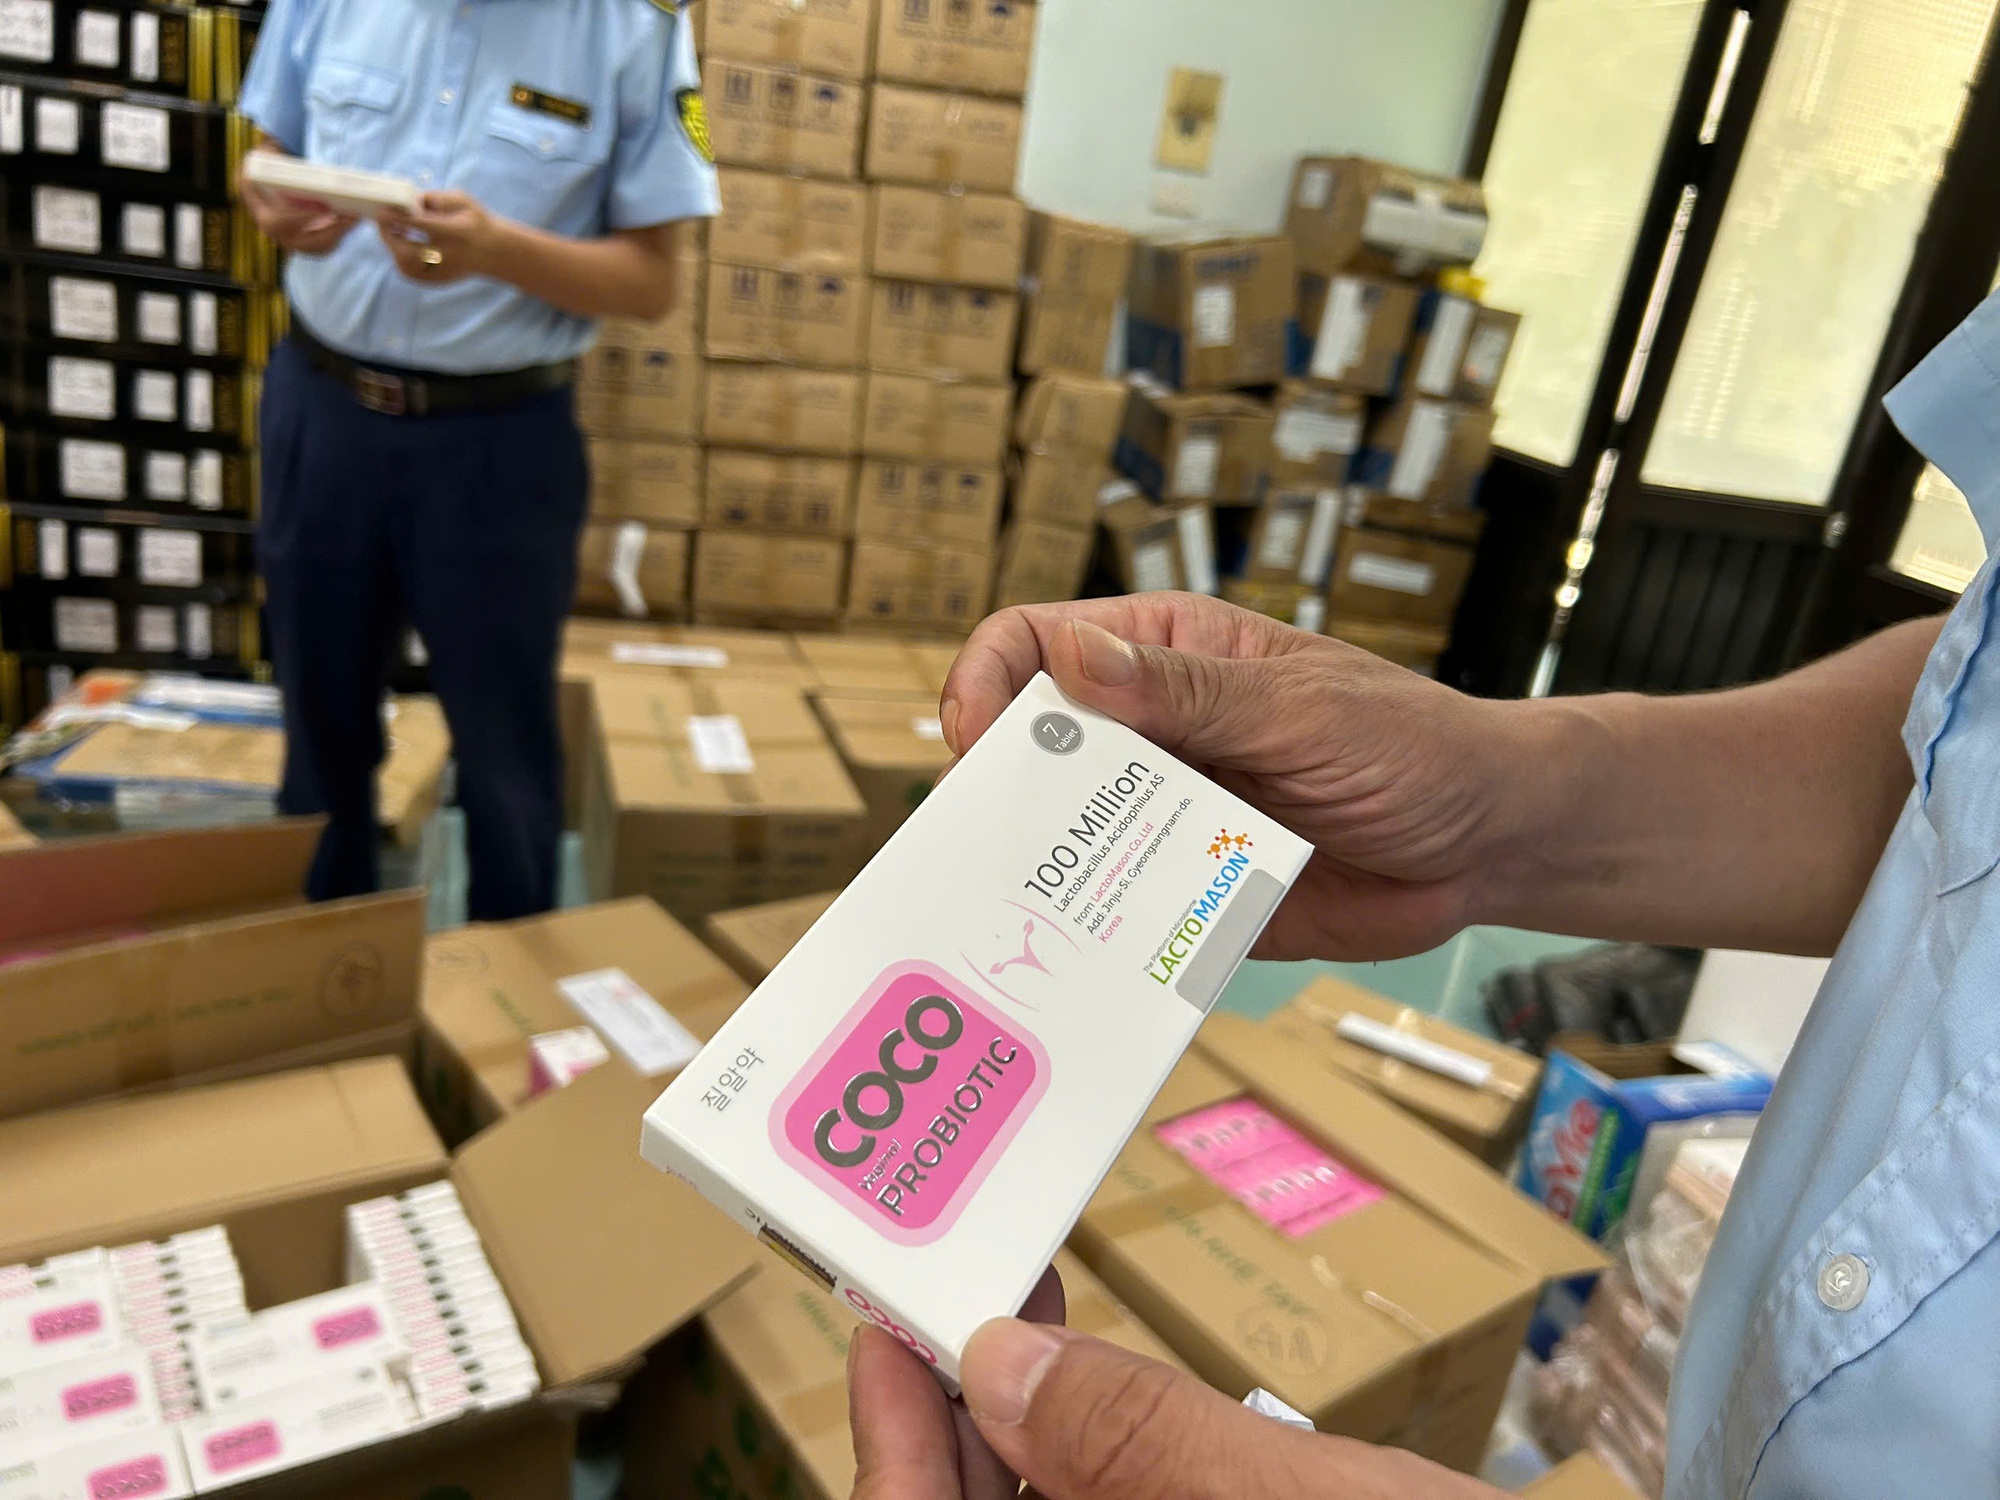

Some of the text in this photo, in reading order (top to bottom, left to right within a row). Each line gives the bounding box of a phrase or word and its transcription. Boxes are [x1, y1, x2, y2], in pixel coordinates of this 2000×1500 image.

[1042, 722, 1059, 738] 7
[1054, 729, 1079, 751] Tablet
[1024, 761, 1150, 898] 100 Million
[1054, 773, 1165, 912] Lactobacillus Acidophilus AS
[1086, 911, 1107, 935] Add:
[1127, 797, 1194, 879] Gyeongsangnam-do,
[1073, 902, 1095, 926] from
[1090, 850, 1133, 903] LactoMason
[1098, 915, 1123, 945] Korea
[1143, 899, 1198, 973] The Platform of Microbiome
[701, 1047, 764, 1111] 질알약
[813, 995, 964, 1168] COCO
[875, 1036, 1017, 1216] PROBIOTIC
[844, 1287, 938, 1365] COCO
